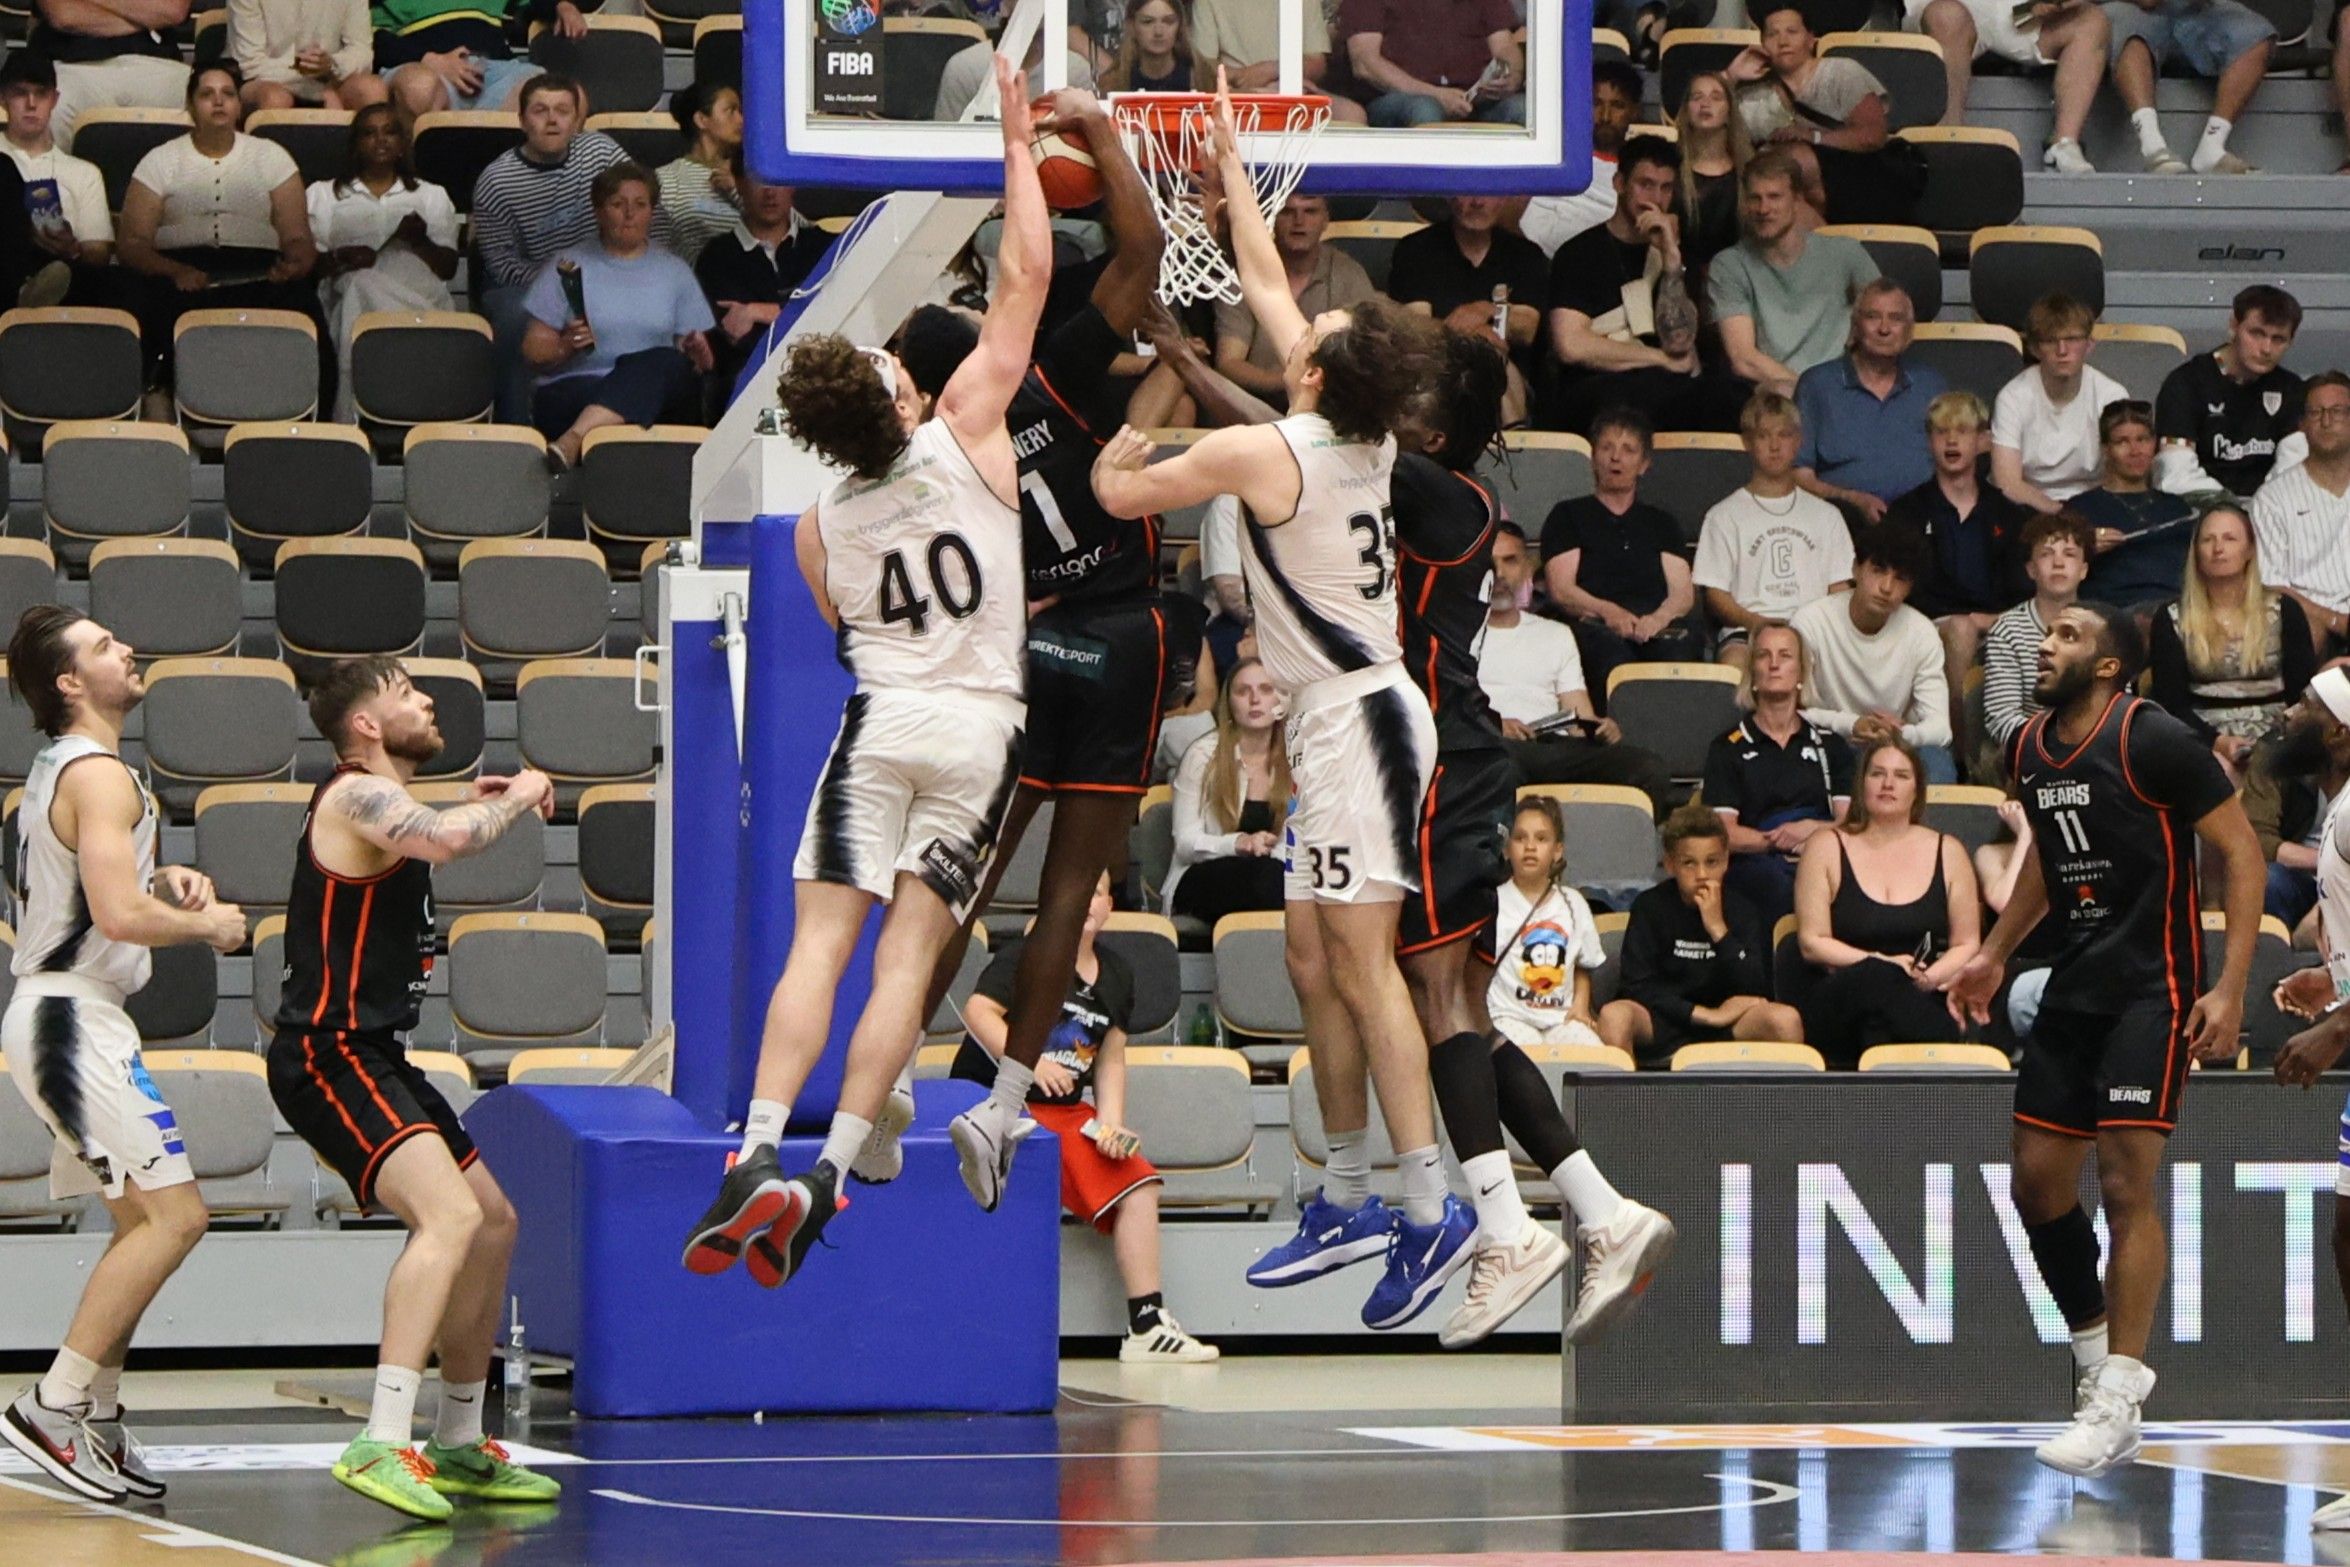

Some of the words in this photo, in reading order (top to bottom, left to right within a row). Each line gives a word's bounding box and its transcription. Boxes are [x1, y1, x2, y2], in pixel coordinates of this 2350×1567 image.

[828, 51, 874, 76] FIBA
[877, 529, 985, 638] 40
[2036, 783, 2090, 809] BEARS
[2054, 810, 2090, 853] 11
[2109, 1088, 2152, 1104] BEARS
